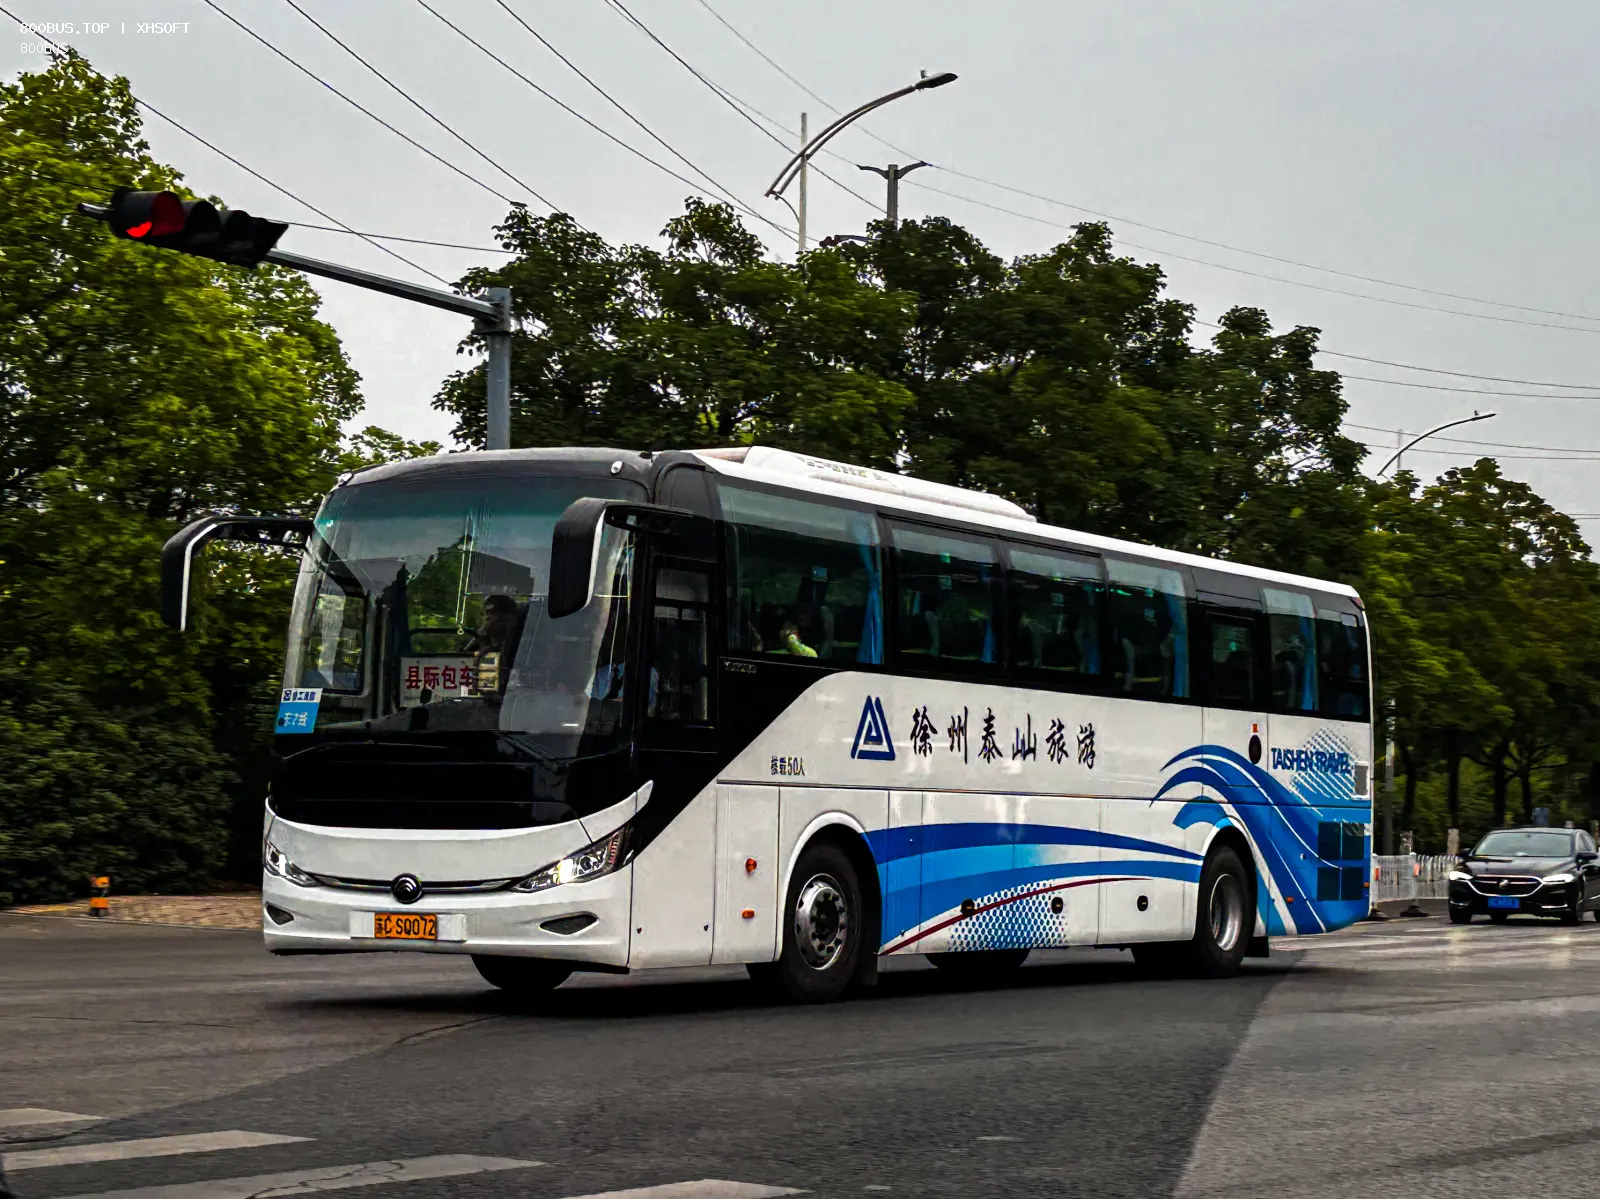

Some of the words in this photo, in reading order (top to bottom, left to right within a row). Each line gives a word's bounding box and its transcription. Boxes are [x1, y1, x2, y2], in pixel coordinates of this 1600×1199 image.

[405, 665, 476, 690] 县际包车
[910, 706, 1096, 769] 徐州泰山旅游
